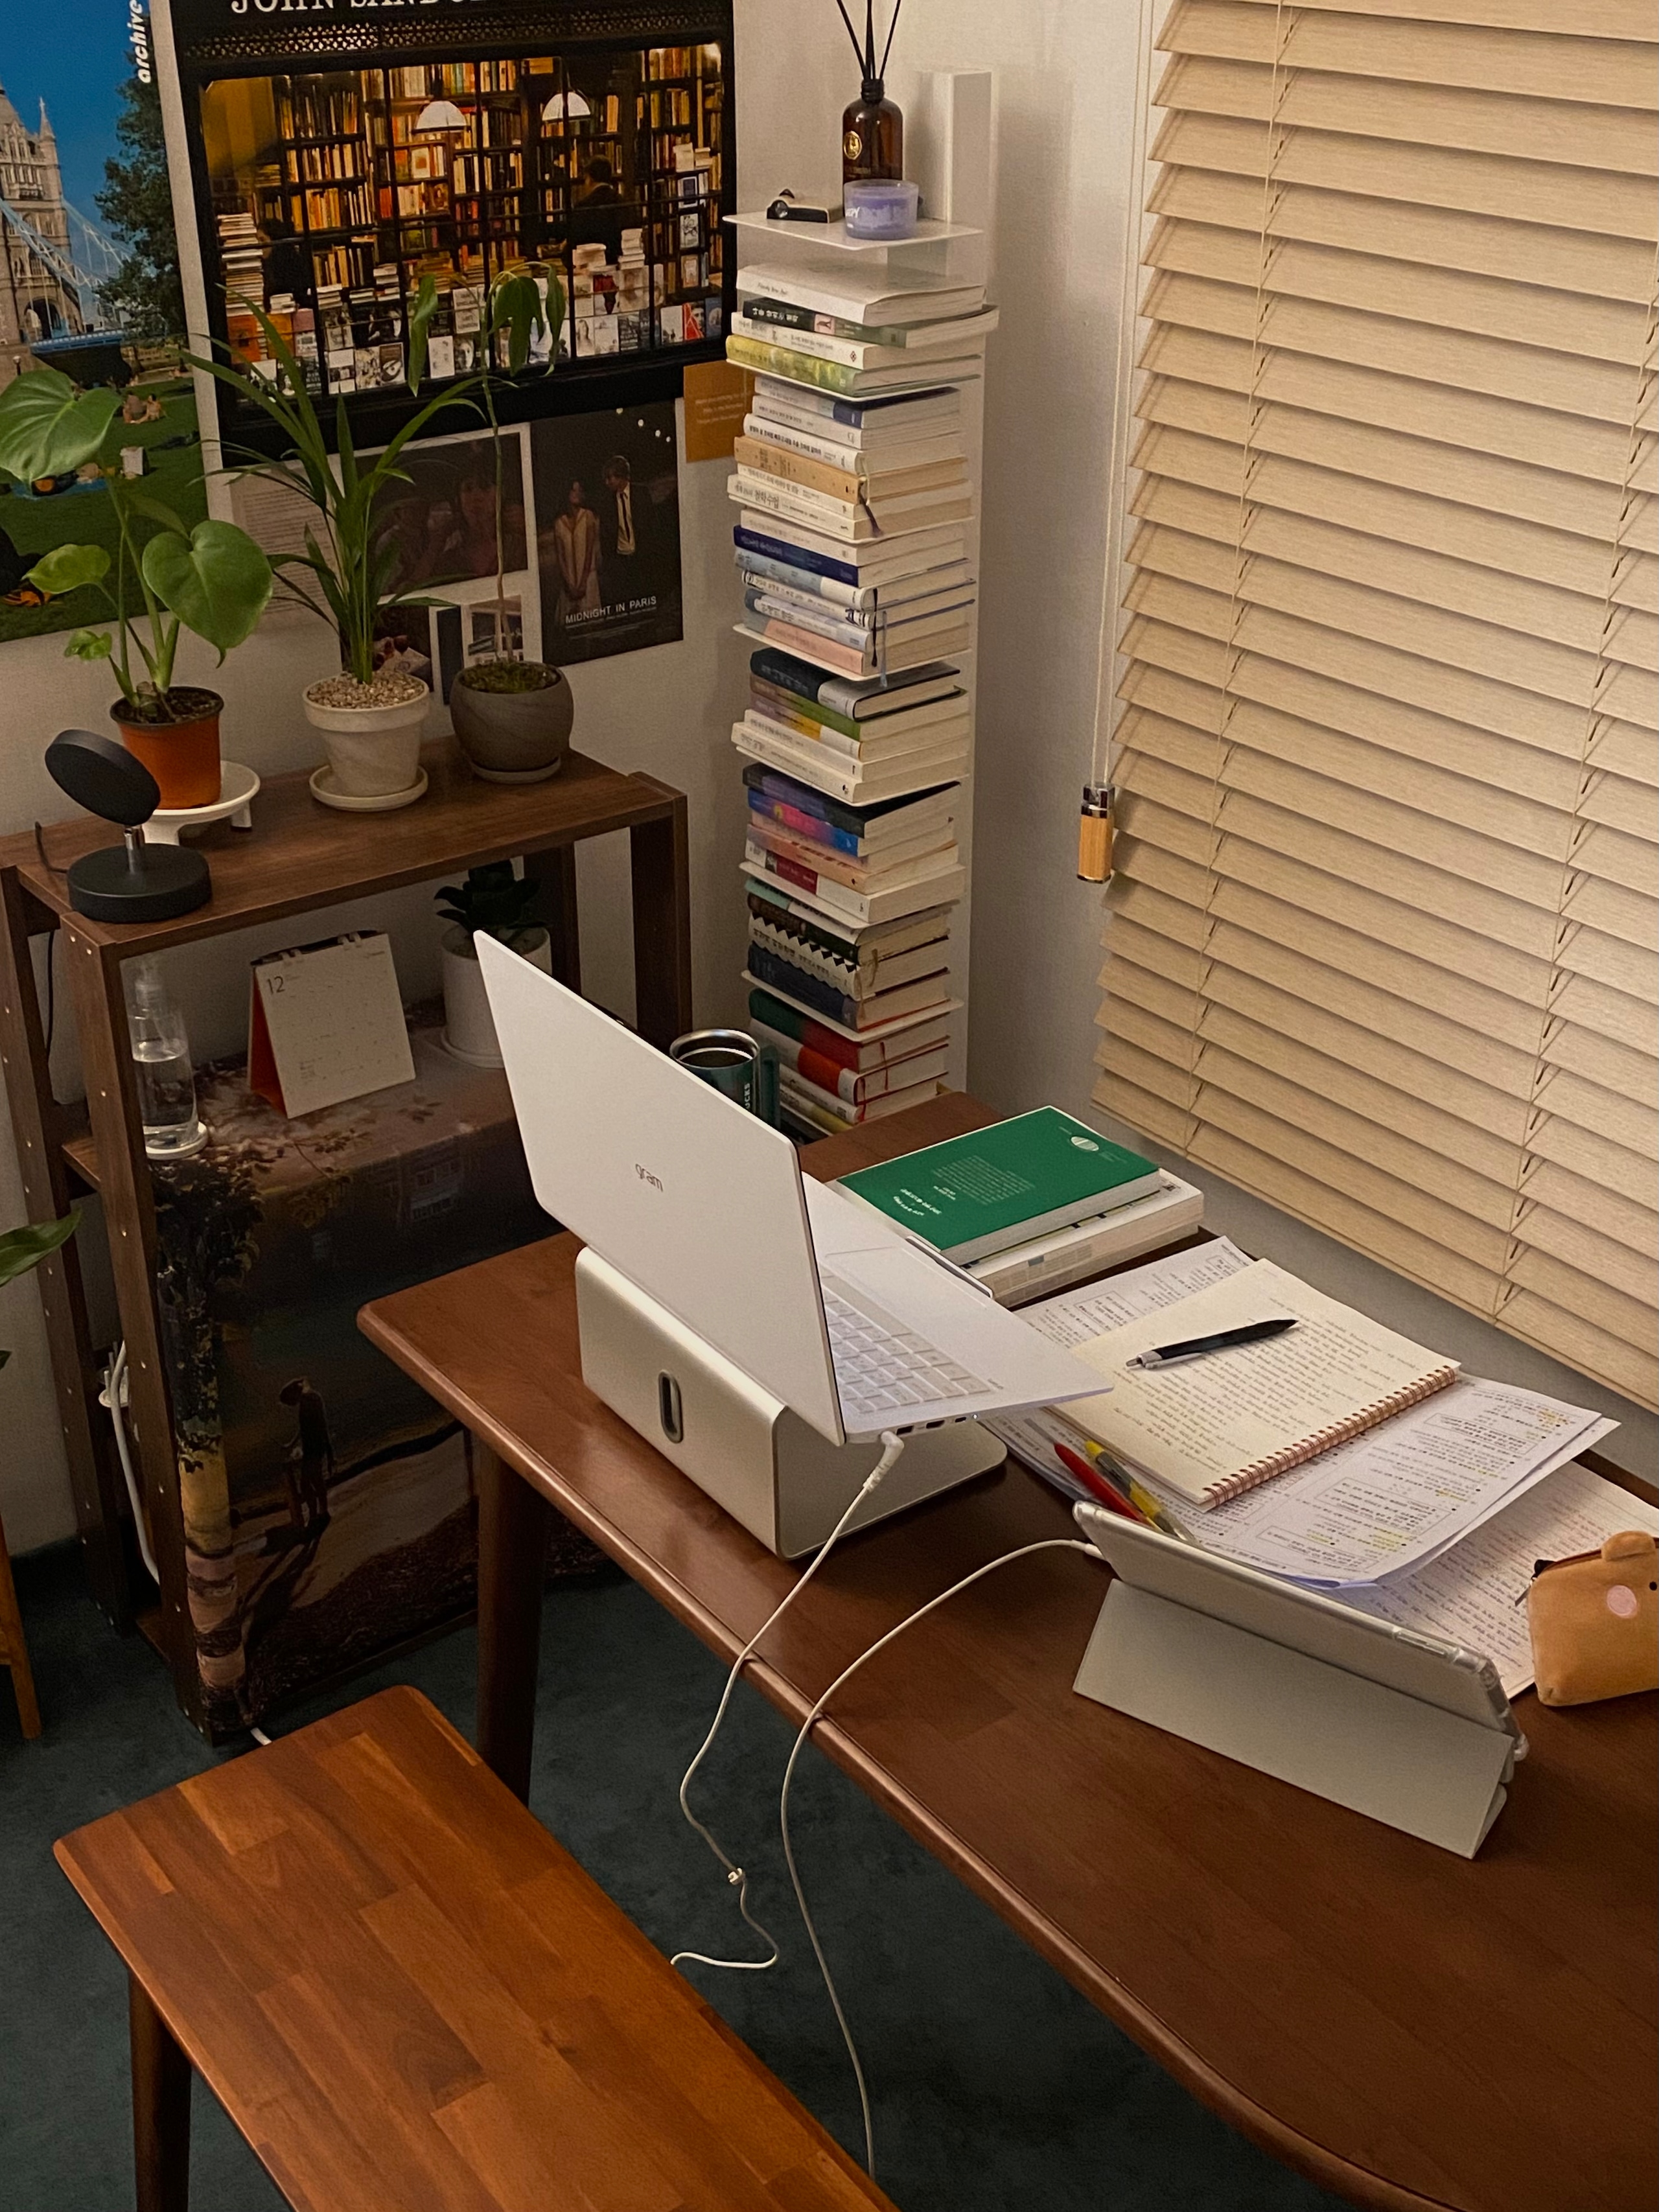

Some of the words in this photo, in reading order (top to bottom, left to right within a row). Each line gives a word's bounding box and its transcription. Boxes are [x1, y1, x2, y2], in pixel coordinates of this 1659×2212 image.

[127, 0, 151, 83] archive
[566, 606, 611, 623] MIDNIGHT
[616, 603, 625, 612] IN
[629, 596, 657, 609] PARIS
[266, 976, 285, 994] 12
[635, 1163, 663, 1192] gram
